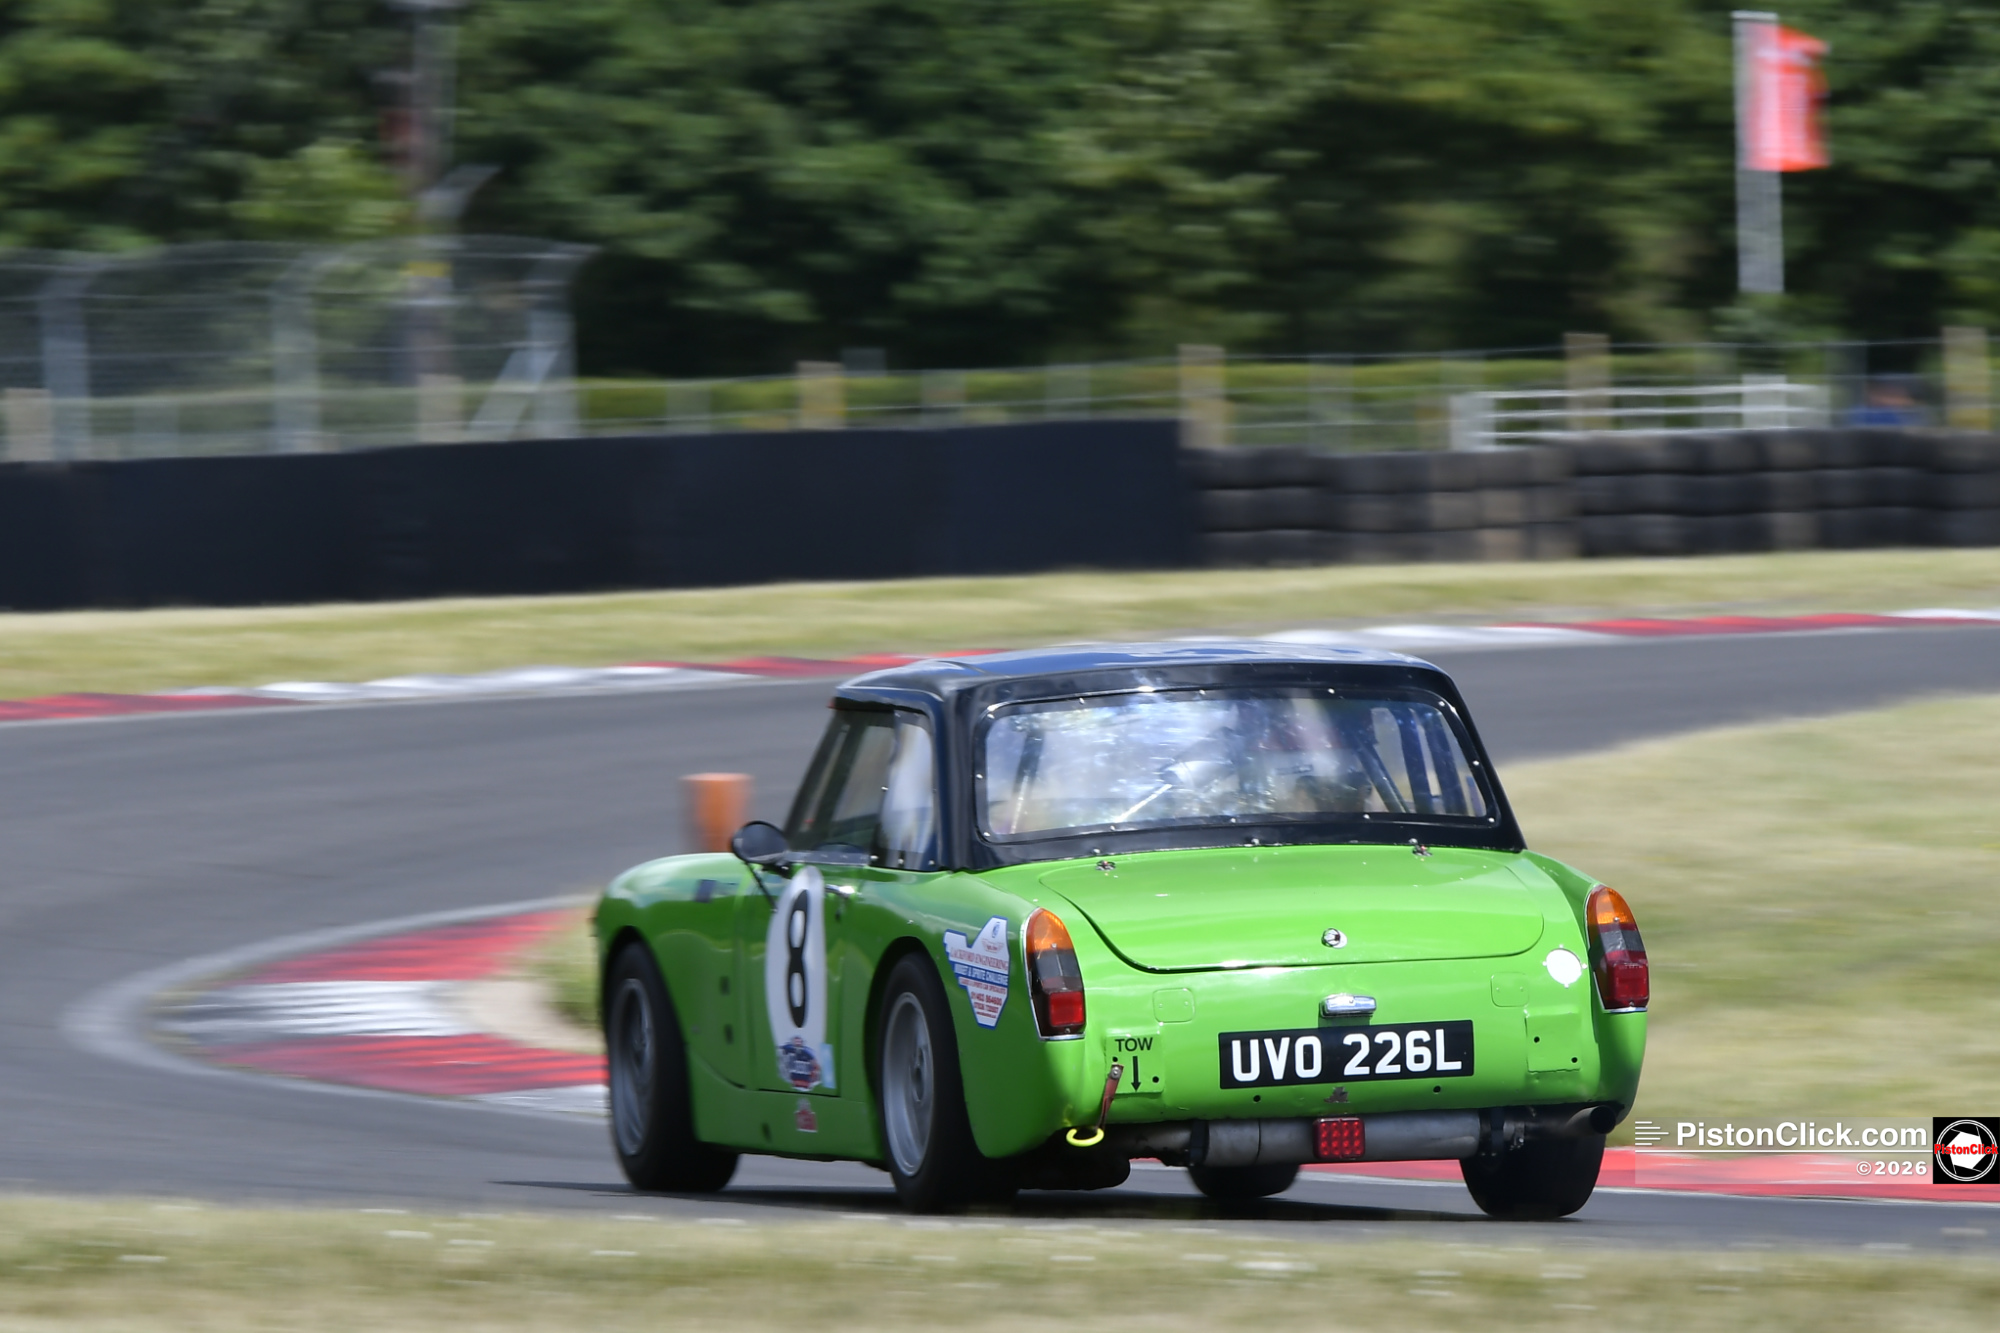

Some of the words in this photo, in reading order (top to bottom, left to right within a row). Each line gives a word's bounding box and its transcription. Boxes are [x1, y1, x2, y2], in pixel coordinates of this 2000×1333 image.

[787, 889, 809, 1029] 8
[975, 954, 1009, 971] ENGINEERING
[986, 970, 1009, 986] CHALLENGE
[1114, 1037, 1153, 1052] TOW
[1231, 1035, 1322, 1082] UVO
[1343, 1029, 1462, 1076] 226L
